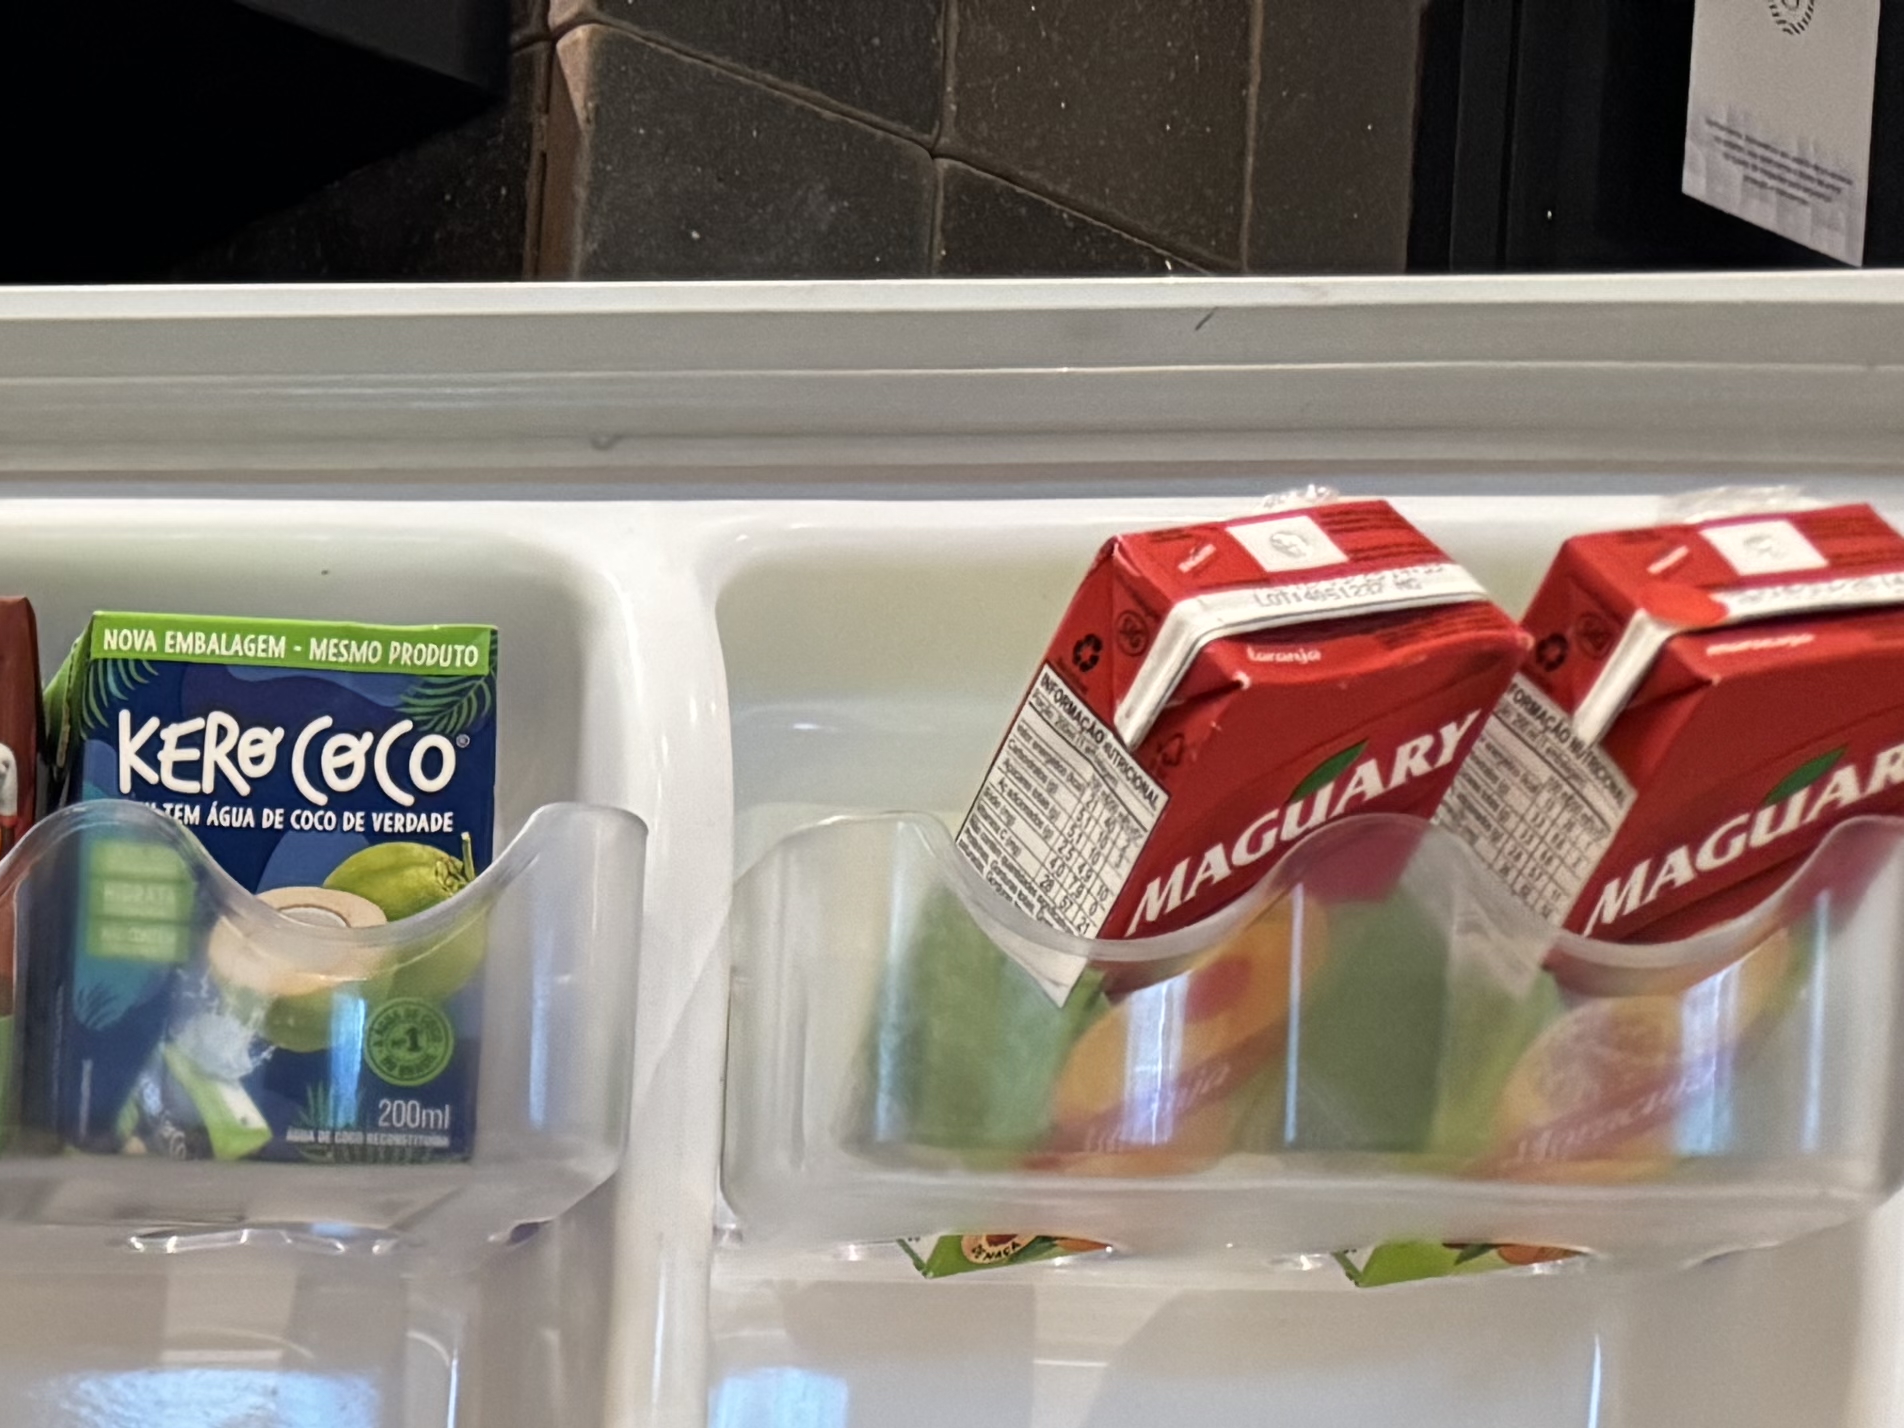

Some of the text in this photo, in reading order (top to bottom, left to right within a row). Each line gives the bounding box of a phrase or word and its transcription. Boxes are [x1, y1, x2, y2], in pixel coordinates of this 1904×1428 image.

[103, 628, 479, 667] NOVA EMBALAGEM MESMO PRODUTO
[1036, 673, 1106, 748] INFORMAÇÃO
[118, 709, 456, 807] KERO COCO
[206, 800, 254, 828] ÁGUA
[261, 808, 283, 829] DE
[290, 809, 337, 831] COCO
[342, 811, 365, 832] DE
[372, 812, 454, 833] VERDADE
[1125, 709, 1481, 938] MAGUARY
[1583, 743, 1904, 937] MAGUAR
[378, 1098, 451, 1131] 200ml
